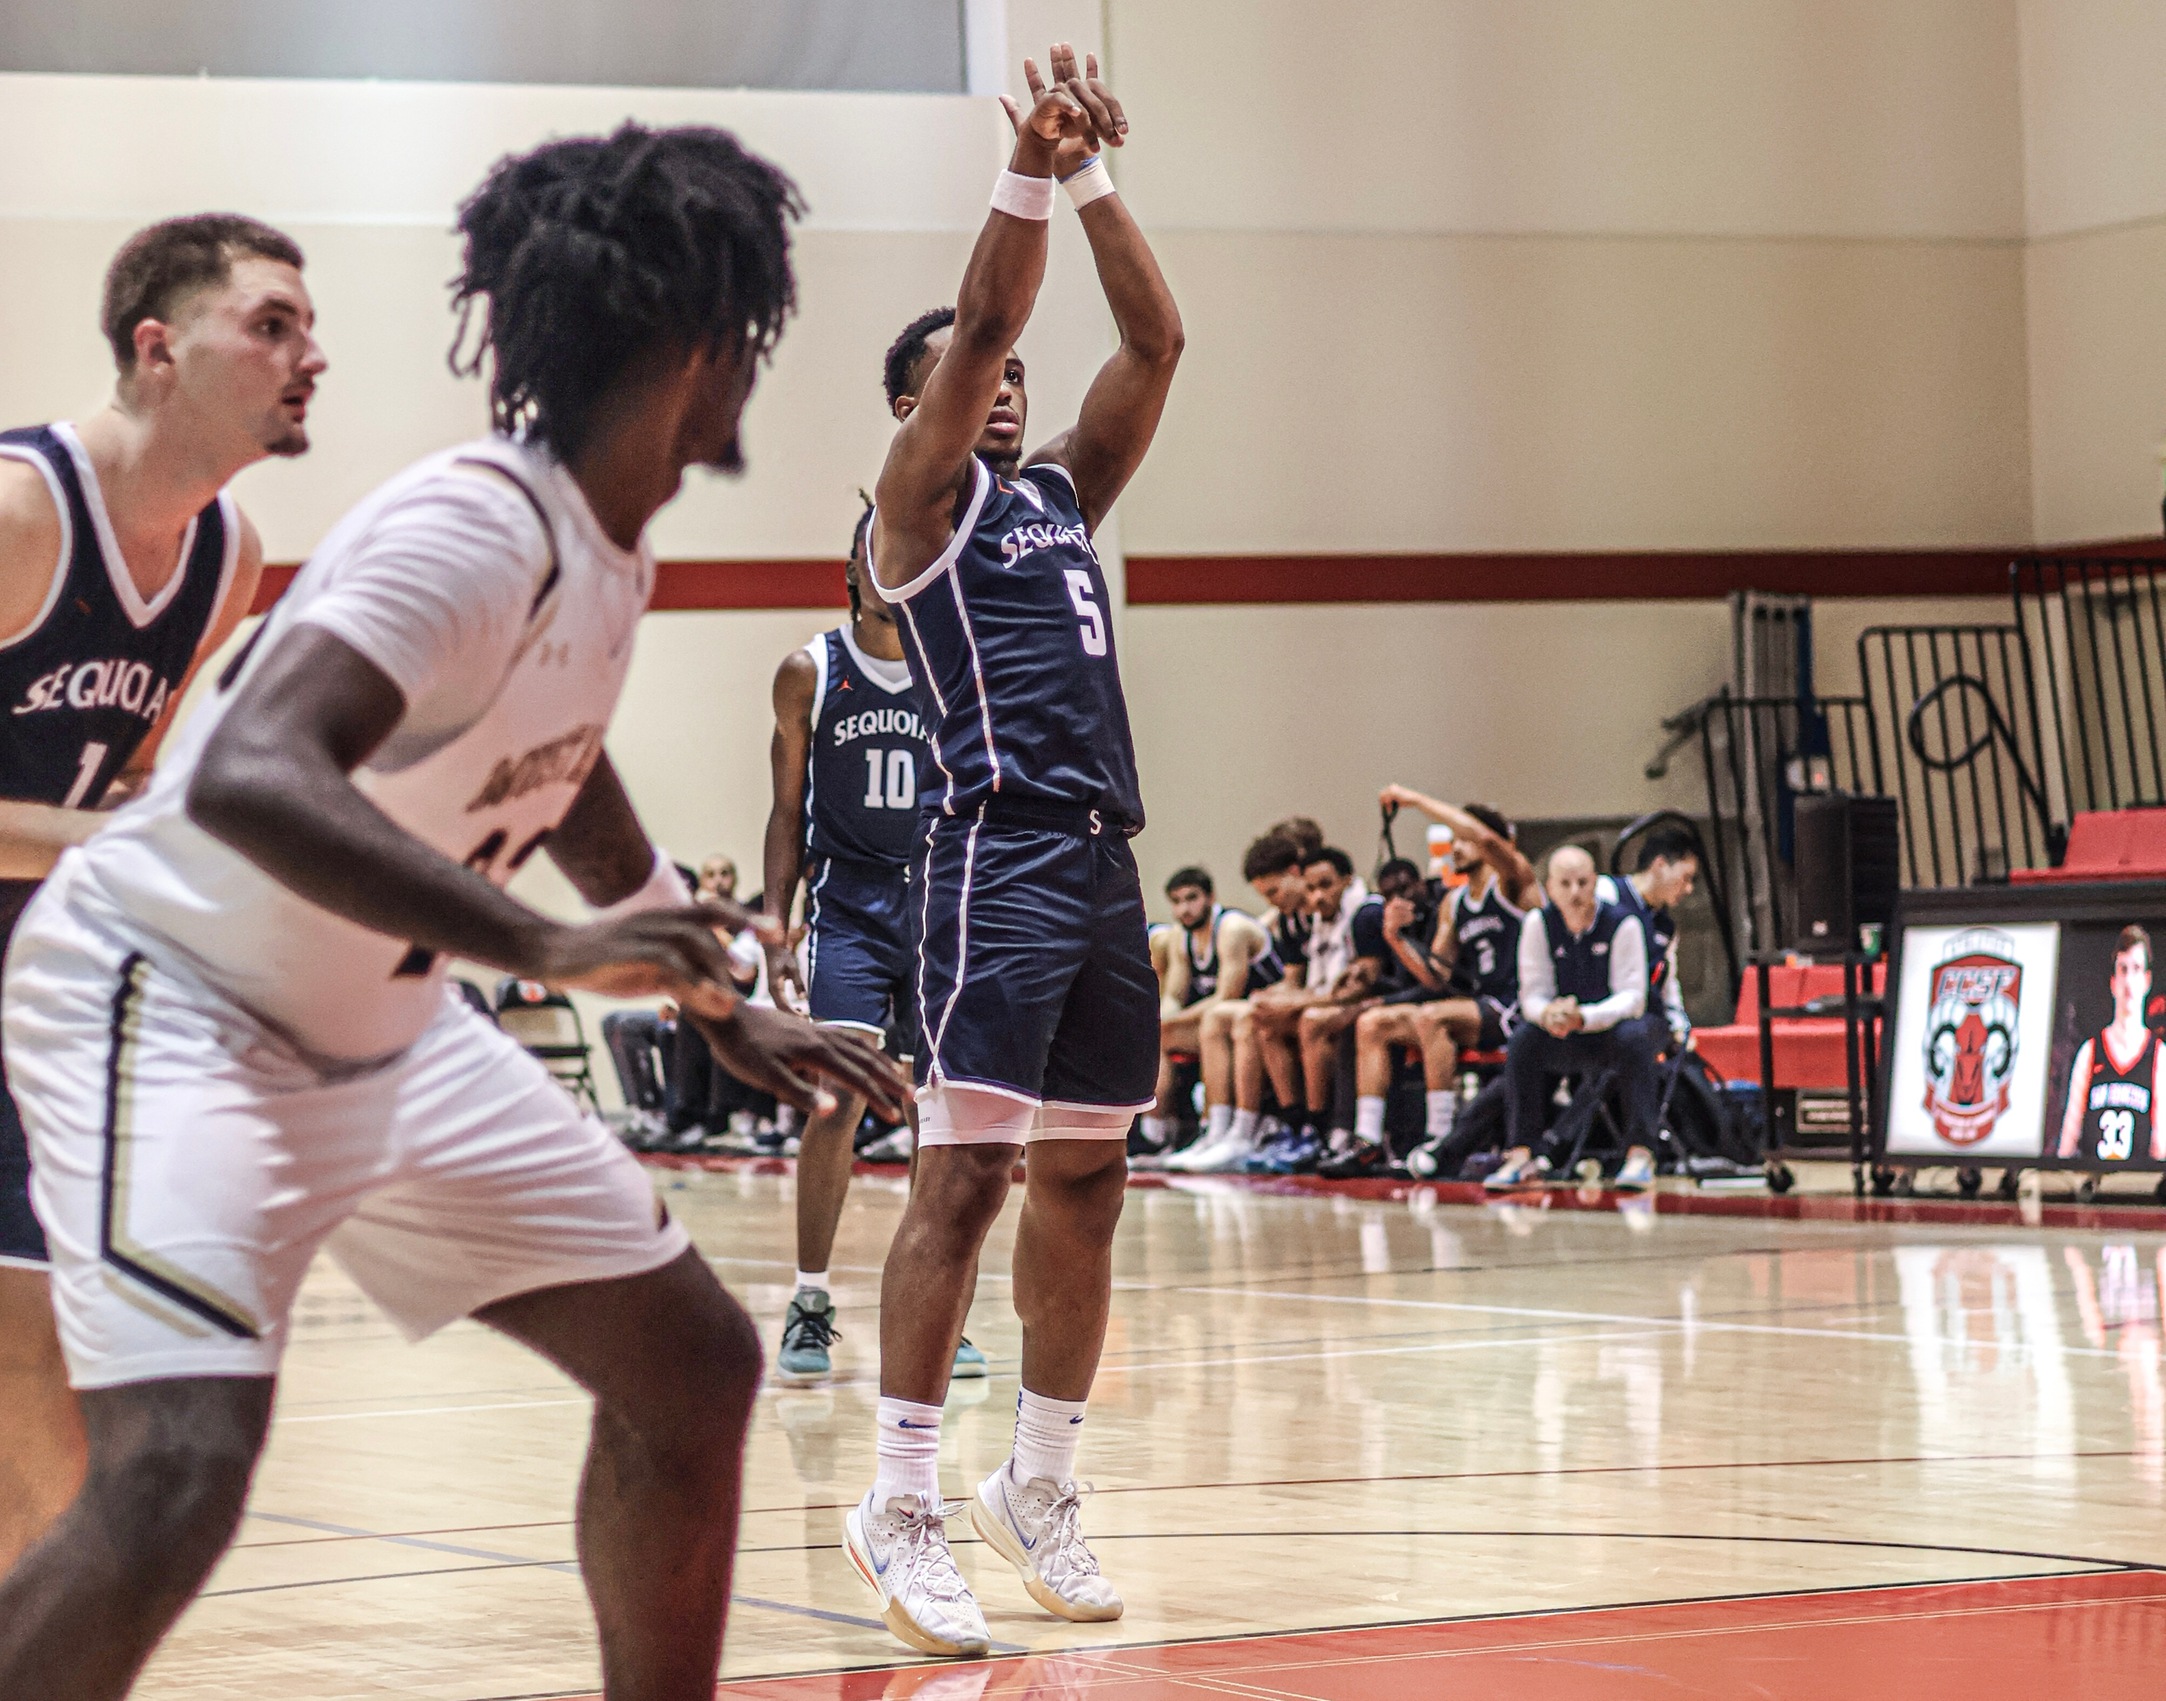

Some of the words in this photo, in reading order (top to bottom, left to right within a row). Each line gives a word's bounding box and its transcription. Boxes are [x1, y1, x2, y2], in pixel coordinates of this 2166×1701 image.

[1063, 569, 1107, 656] 5
[64, 741, 107, 808] 1
[864, 748, 916, 809] 10
[1089, 808, 1102, 835] S
[2096, 1109, 2135, 1160] 33
